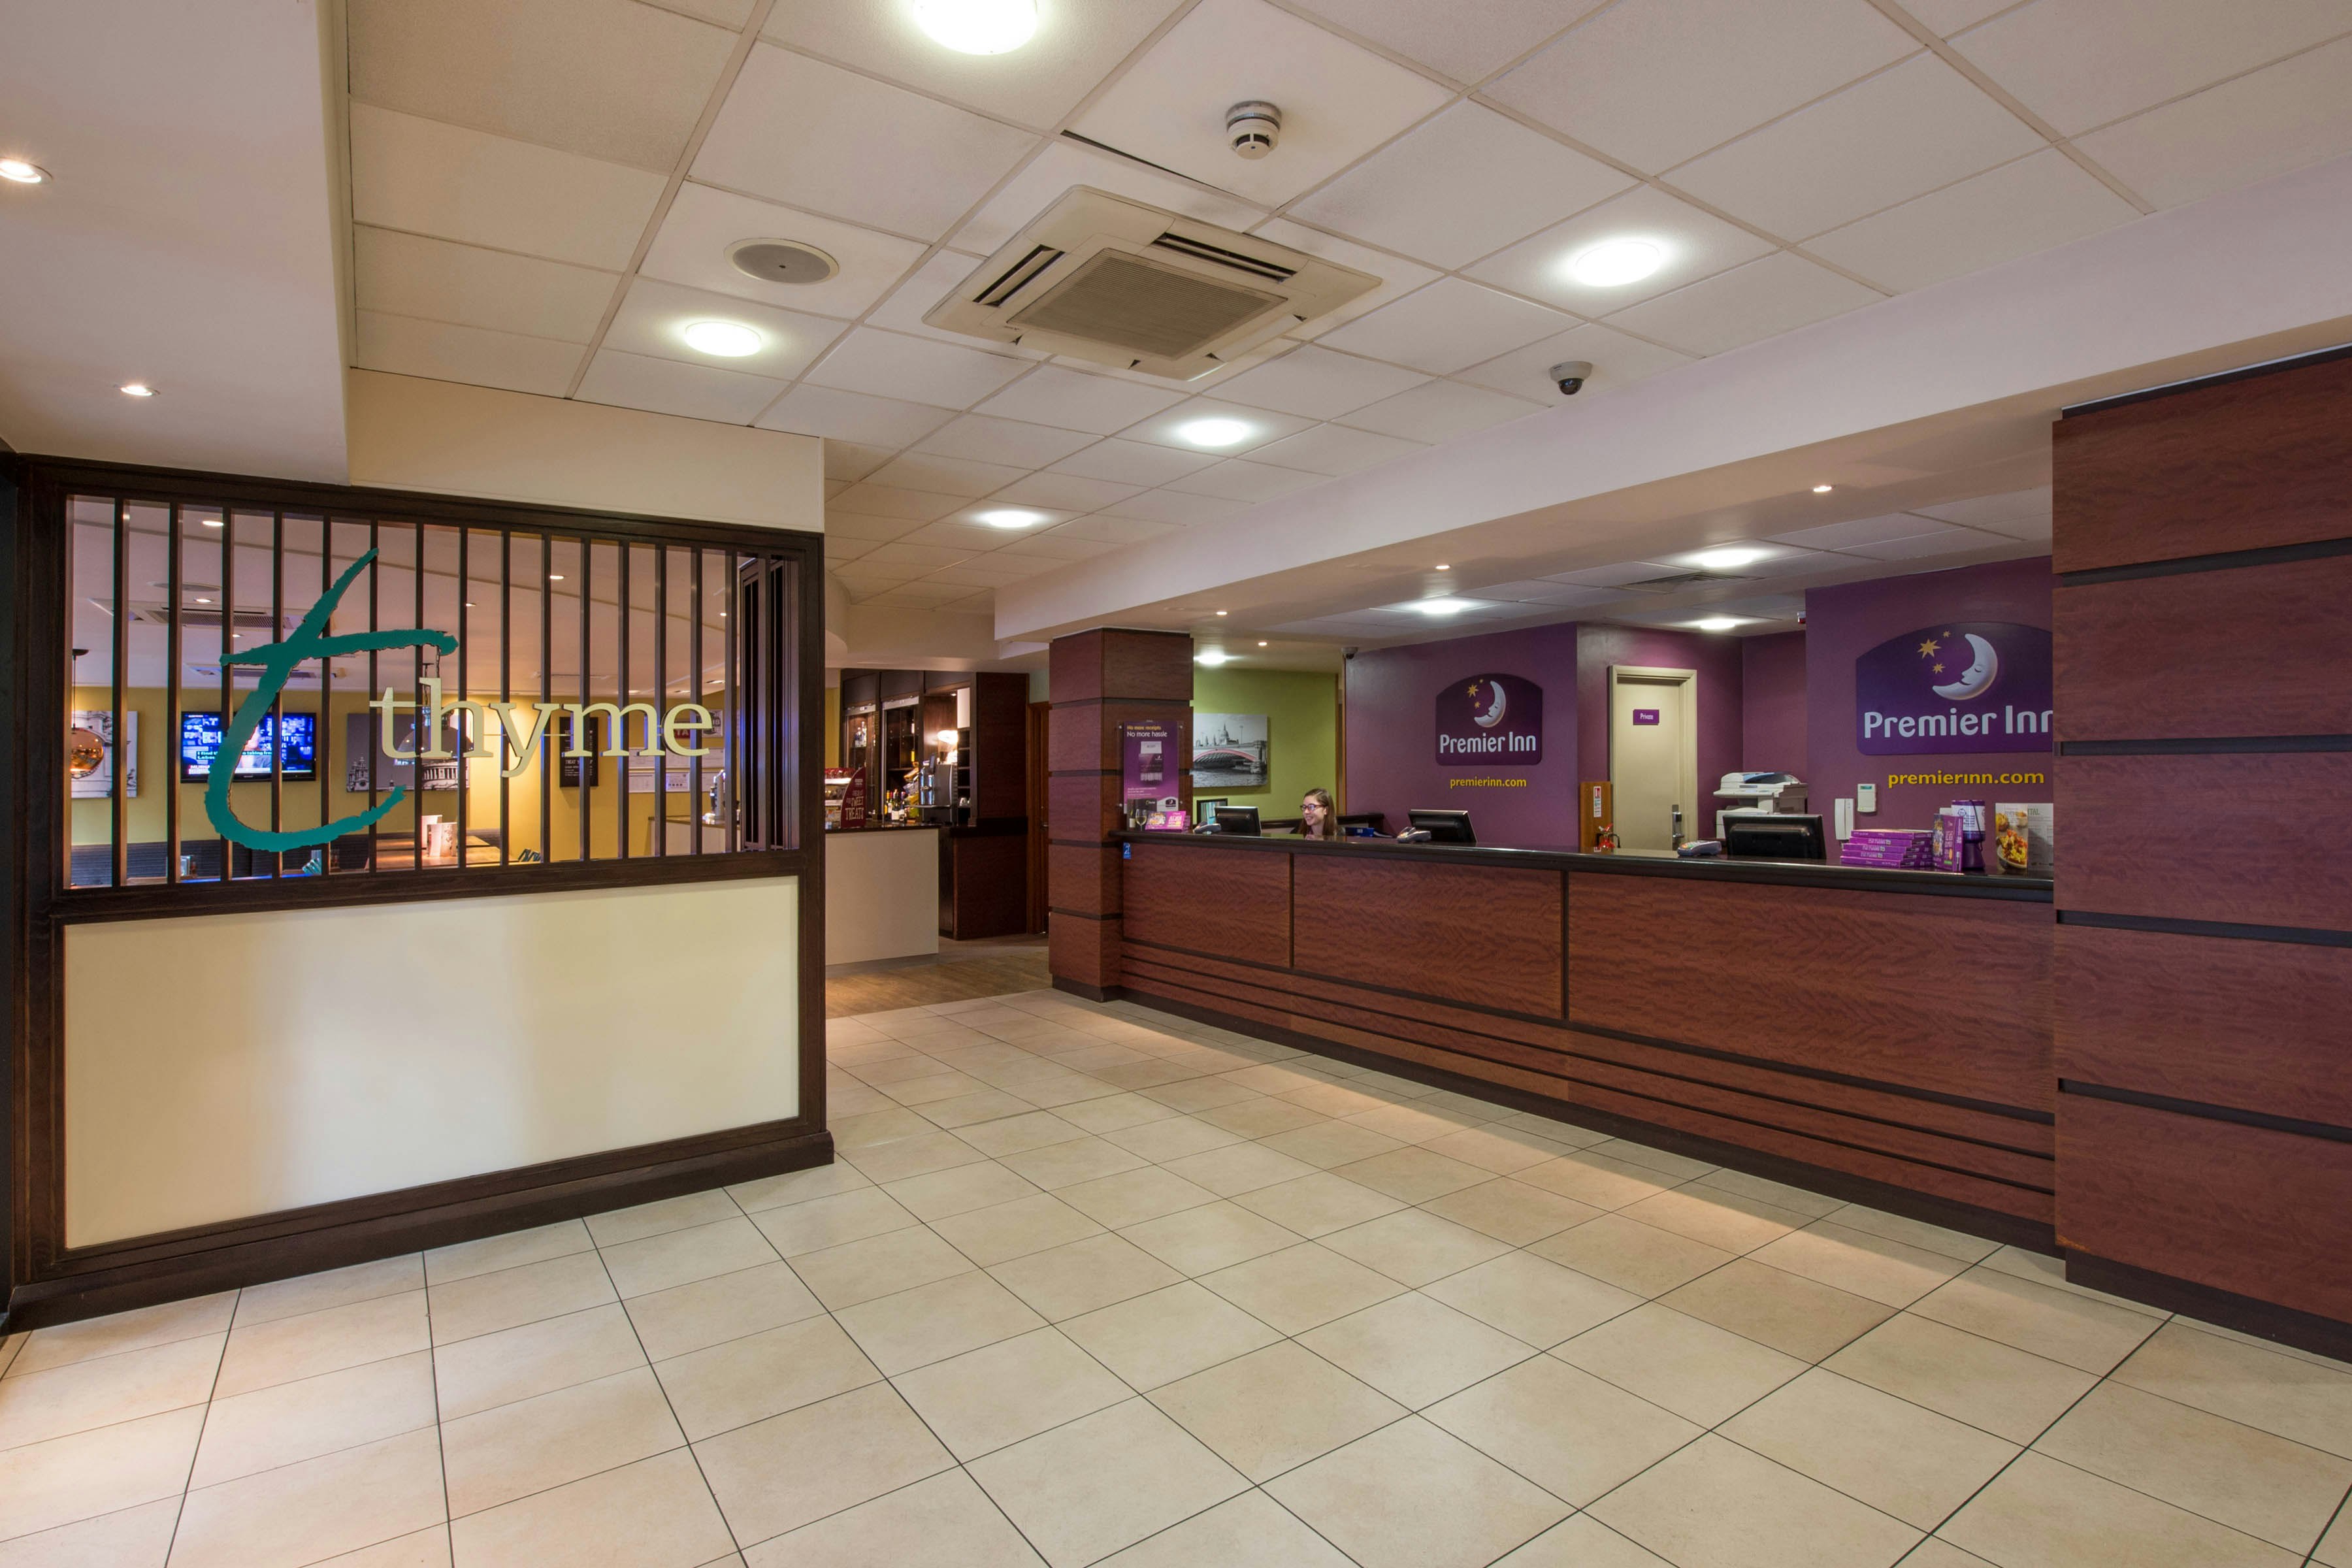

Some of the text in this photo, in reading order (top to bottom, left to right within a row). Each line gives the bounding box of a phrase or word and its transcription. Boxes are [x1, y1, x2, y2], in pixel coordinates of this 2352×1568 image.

[369, 678, 713, 777] thyme
[1864, 708, 1997, 738] Premier
[1440, 731, 1536, 753] Premier Inn
[1450, 776, 1527, 789] premierinn.com
[1888, 770, 2044, 789] premierinn.com
